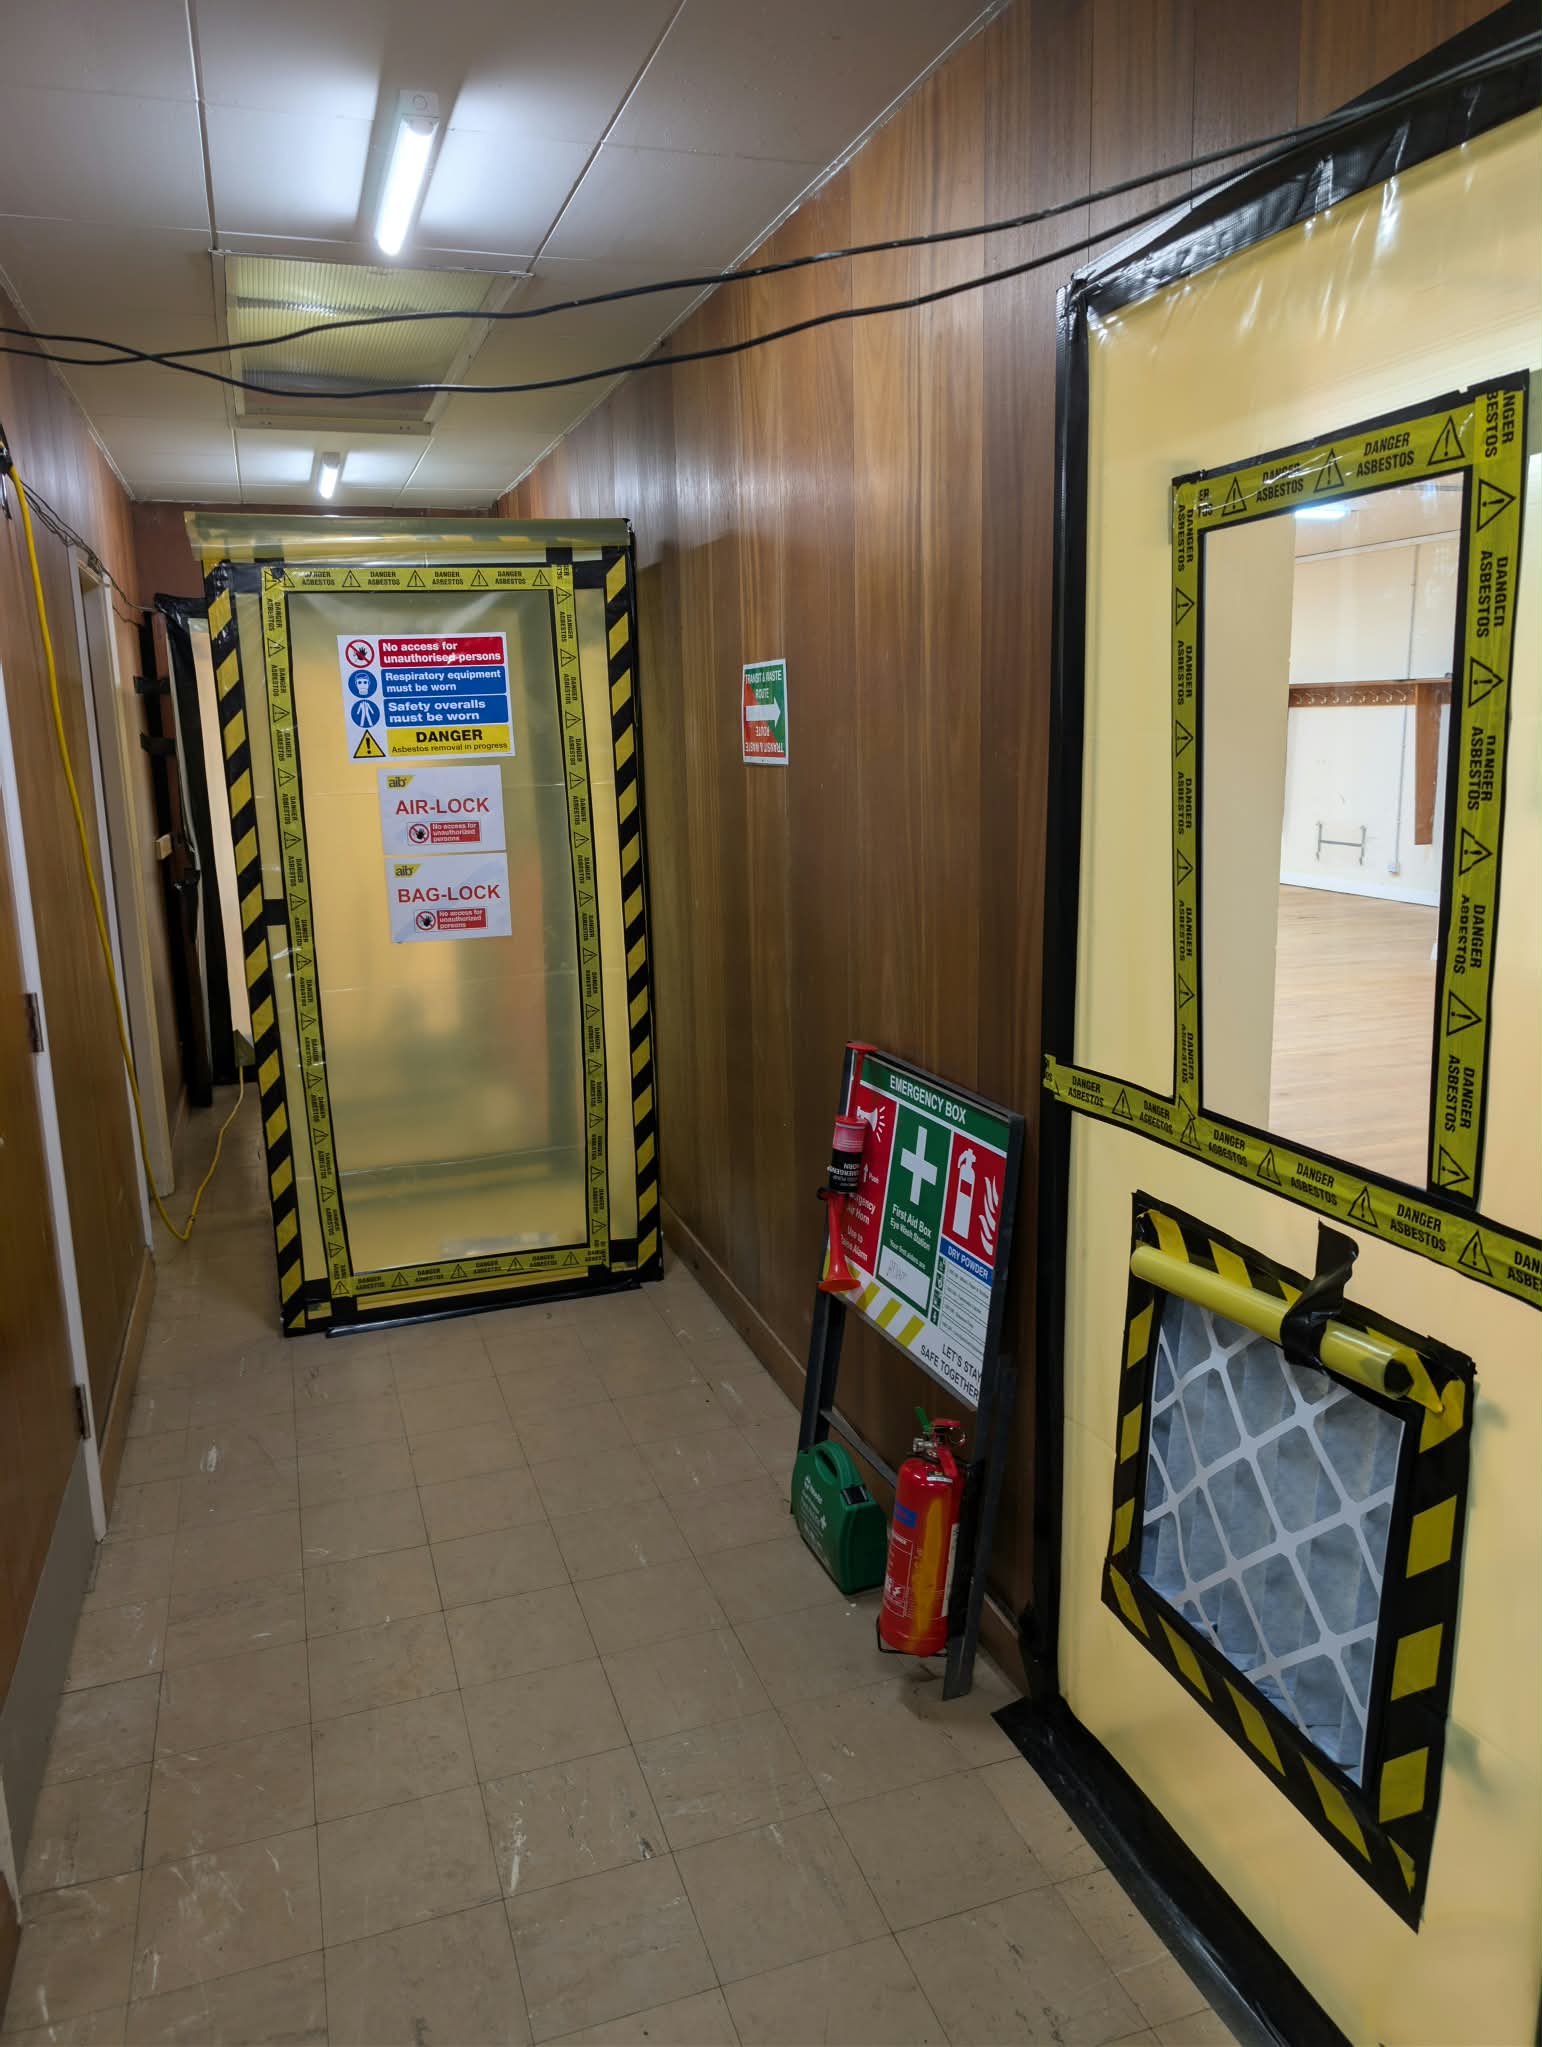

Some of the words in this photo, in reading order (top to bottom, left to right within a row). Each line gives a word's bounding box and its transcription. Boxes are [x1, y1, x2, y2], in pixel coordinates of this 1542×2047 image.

[1502, 390, 1515, 444] NGER
[1364, 432, 1410, 456] DANGER
[1356, 451, 1414, 478] ASBESTOS
[1256, 478, 1303, 503] ASBESTOS
[1177, 504, 1185, 572] ASBESTOS
[1186, 508, 1194, 563] DANGER
[1476, 550, 1492, 638] ASBESTOS
[1494, 556, 1508, 628] DANGER
[382, 643, 398, 652] No
[401, 643, 439, 651] access
[442, 642, 458, 650] for
[458, 653, 501, 664] persons
[386, 672, 444, 682] Respiratory
[447, 670, 501, 680] equipment
[386, 684, 413, 693] must
[415, 683, 428, 692] be
[388, 702, 430, 713] Safety
[434, 700, 486, 710] overalls
[389, 714, 422, 723] must
[426, 713, 443, 722] be
[446, 712, 480, 720] worn
[392, 745, 429, 754] Asbestos
[430, 744, 463, 752] removal
[464, 743, 472, 751] in
[473, 742, 508, 752] progress
[416, 730, 483, 743] DANGER
[1467, 726, 1484, 811] ASBESTOS
[1480, 735, 1496, 802] DANGER
[395, 797, 490, 816] AIR-LOCK
[398, 884, 501, 904] BAG-LOCK
[1453, 894, 1470, 975] ASBESTOS
[1470, 904, 1486, 969] DANGER
[1072, 1075, 1100, 1092] DANGER
[1444, 1054, 1460, 1133] ASBESTOS
[890, 1074, 944, 1113] EMERGENCY
[945, 1101, 966, 1124] BOX
[1068, 1087, 1104, 1108] ASBESTOS
[1144, 1100, 1170, 1120] DANGER
[1460, 1066, 1475, 1130] DANGER
[1139, 1112, 1173, 1135] ASBESTOS
[1213, 1129, 1246, 1152] DANGER
[1208, 1142, 1248, 1168] ASBESTOS
[1296, 1162, 1335, 1188] DANGER
[1290, 1176, 1338, 1206] ASBESTOS
[890, 1218, 900, 1230] Eye
[892, 1204, 907, 1222] First
[907, 1214, 918, 1229] Aid
[919, 1220, 932, 1239] Box
[1396, 1203, 1442, 1232] DANGER
[1390, 1219, 1446, 1252] ASBESTOS
[948, 1246, 961, 1260] DRY
[960, 1254, 989, 1280] POWDER
[1514, 1250, 1542, 1274] DAN
[920, 1344, 939, 1367] SAFE
[940, 1360, 979, 1401] TOGETHER
[942, 1344, 963, 1367] LET'S
[964, 1360, 982, 1383] STAY
